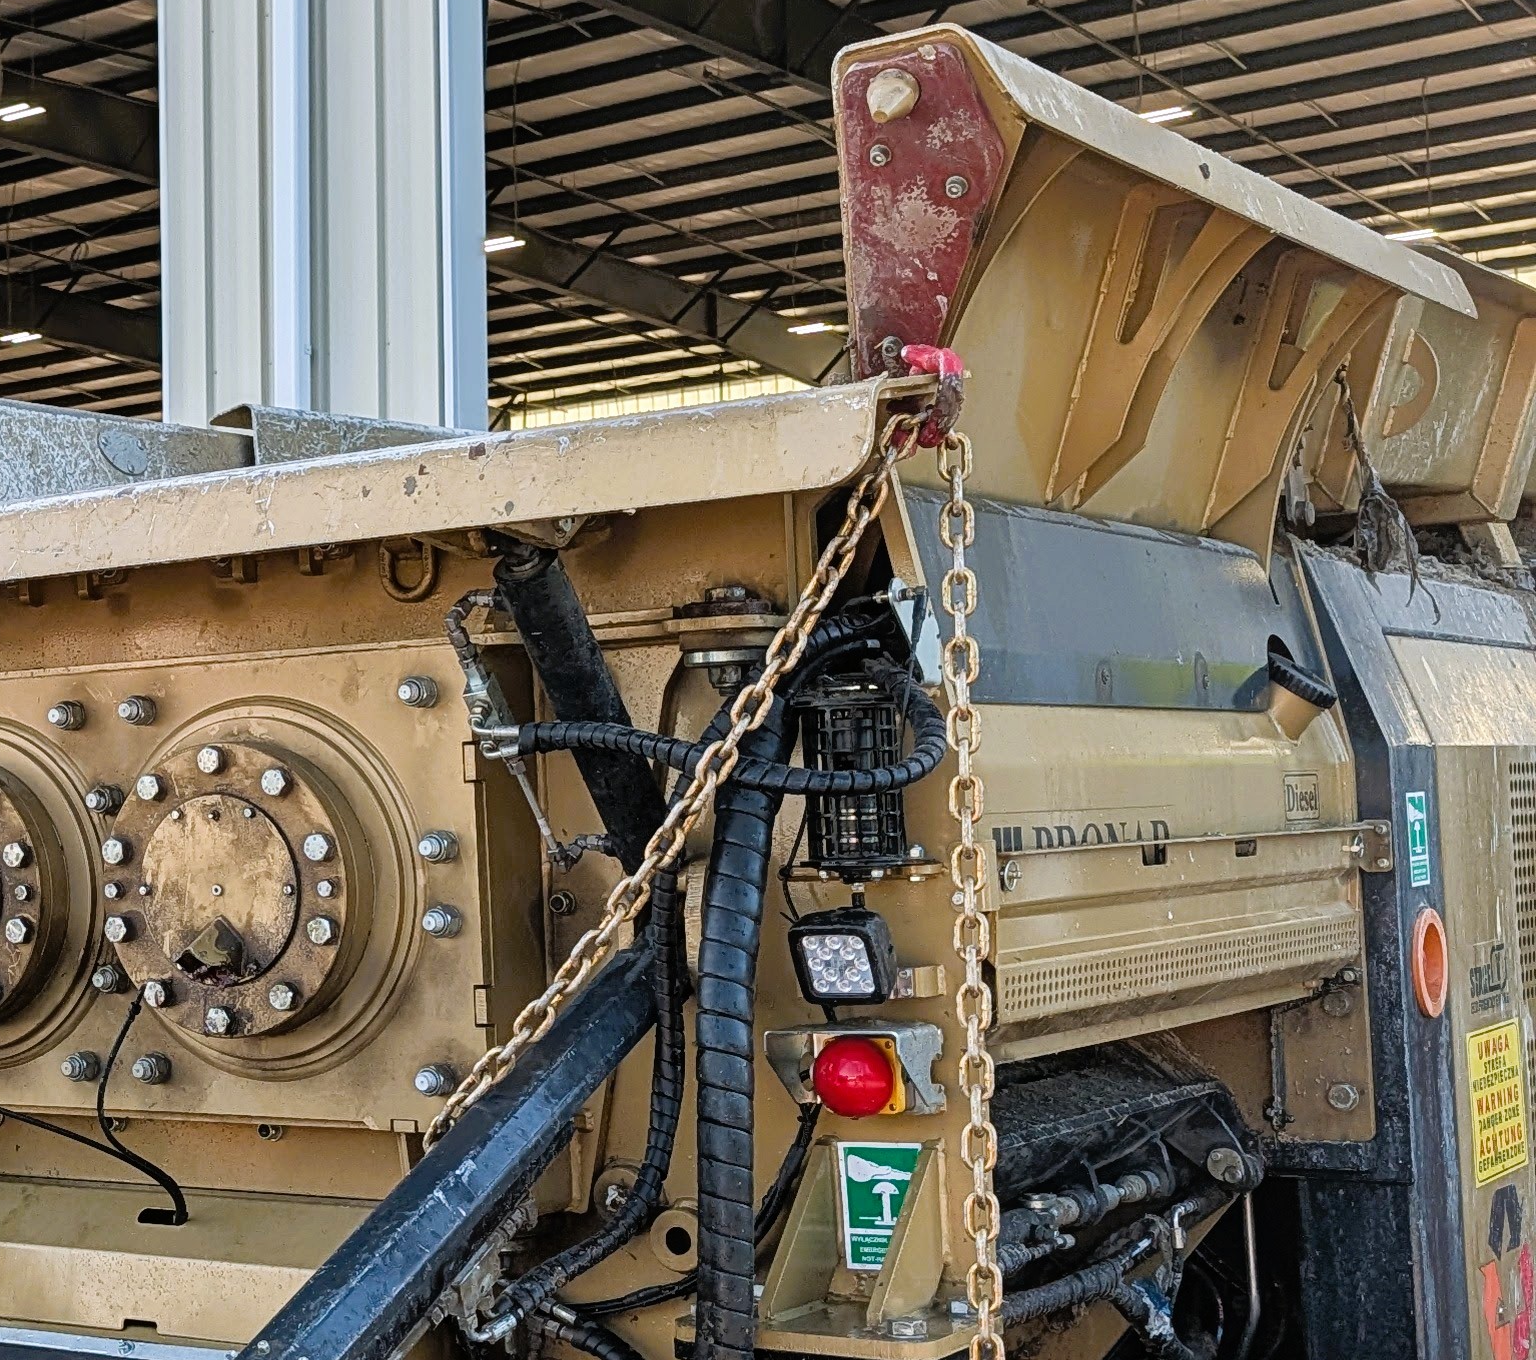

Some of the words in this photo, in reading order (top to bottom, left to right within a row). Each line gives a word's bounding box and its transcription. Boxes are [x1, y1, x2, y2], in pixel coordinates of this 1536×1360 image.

[1285, 783, 1319, 812] Diesel
[1477, 1033, 1510, 1061] UWAGA
[1483, 1054, 1507, 1075] STREFA
[1476, 1083, 1519, 1116] WARNING
[1504, 1104, 1520, 1121] ZONE
[1479, 1122, 1523, 1158] ACHTUNG
